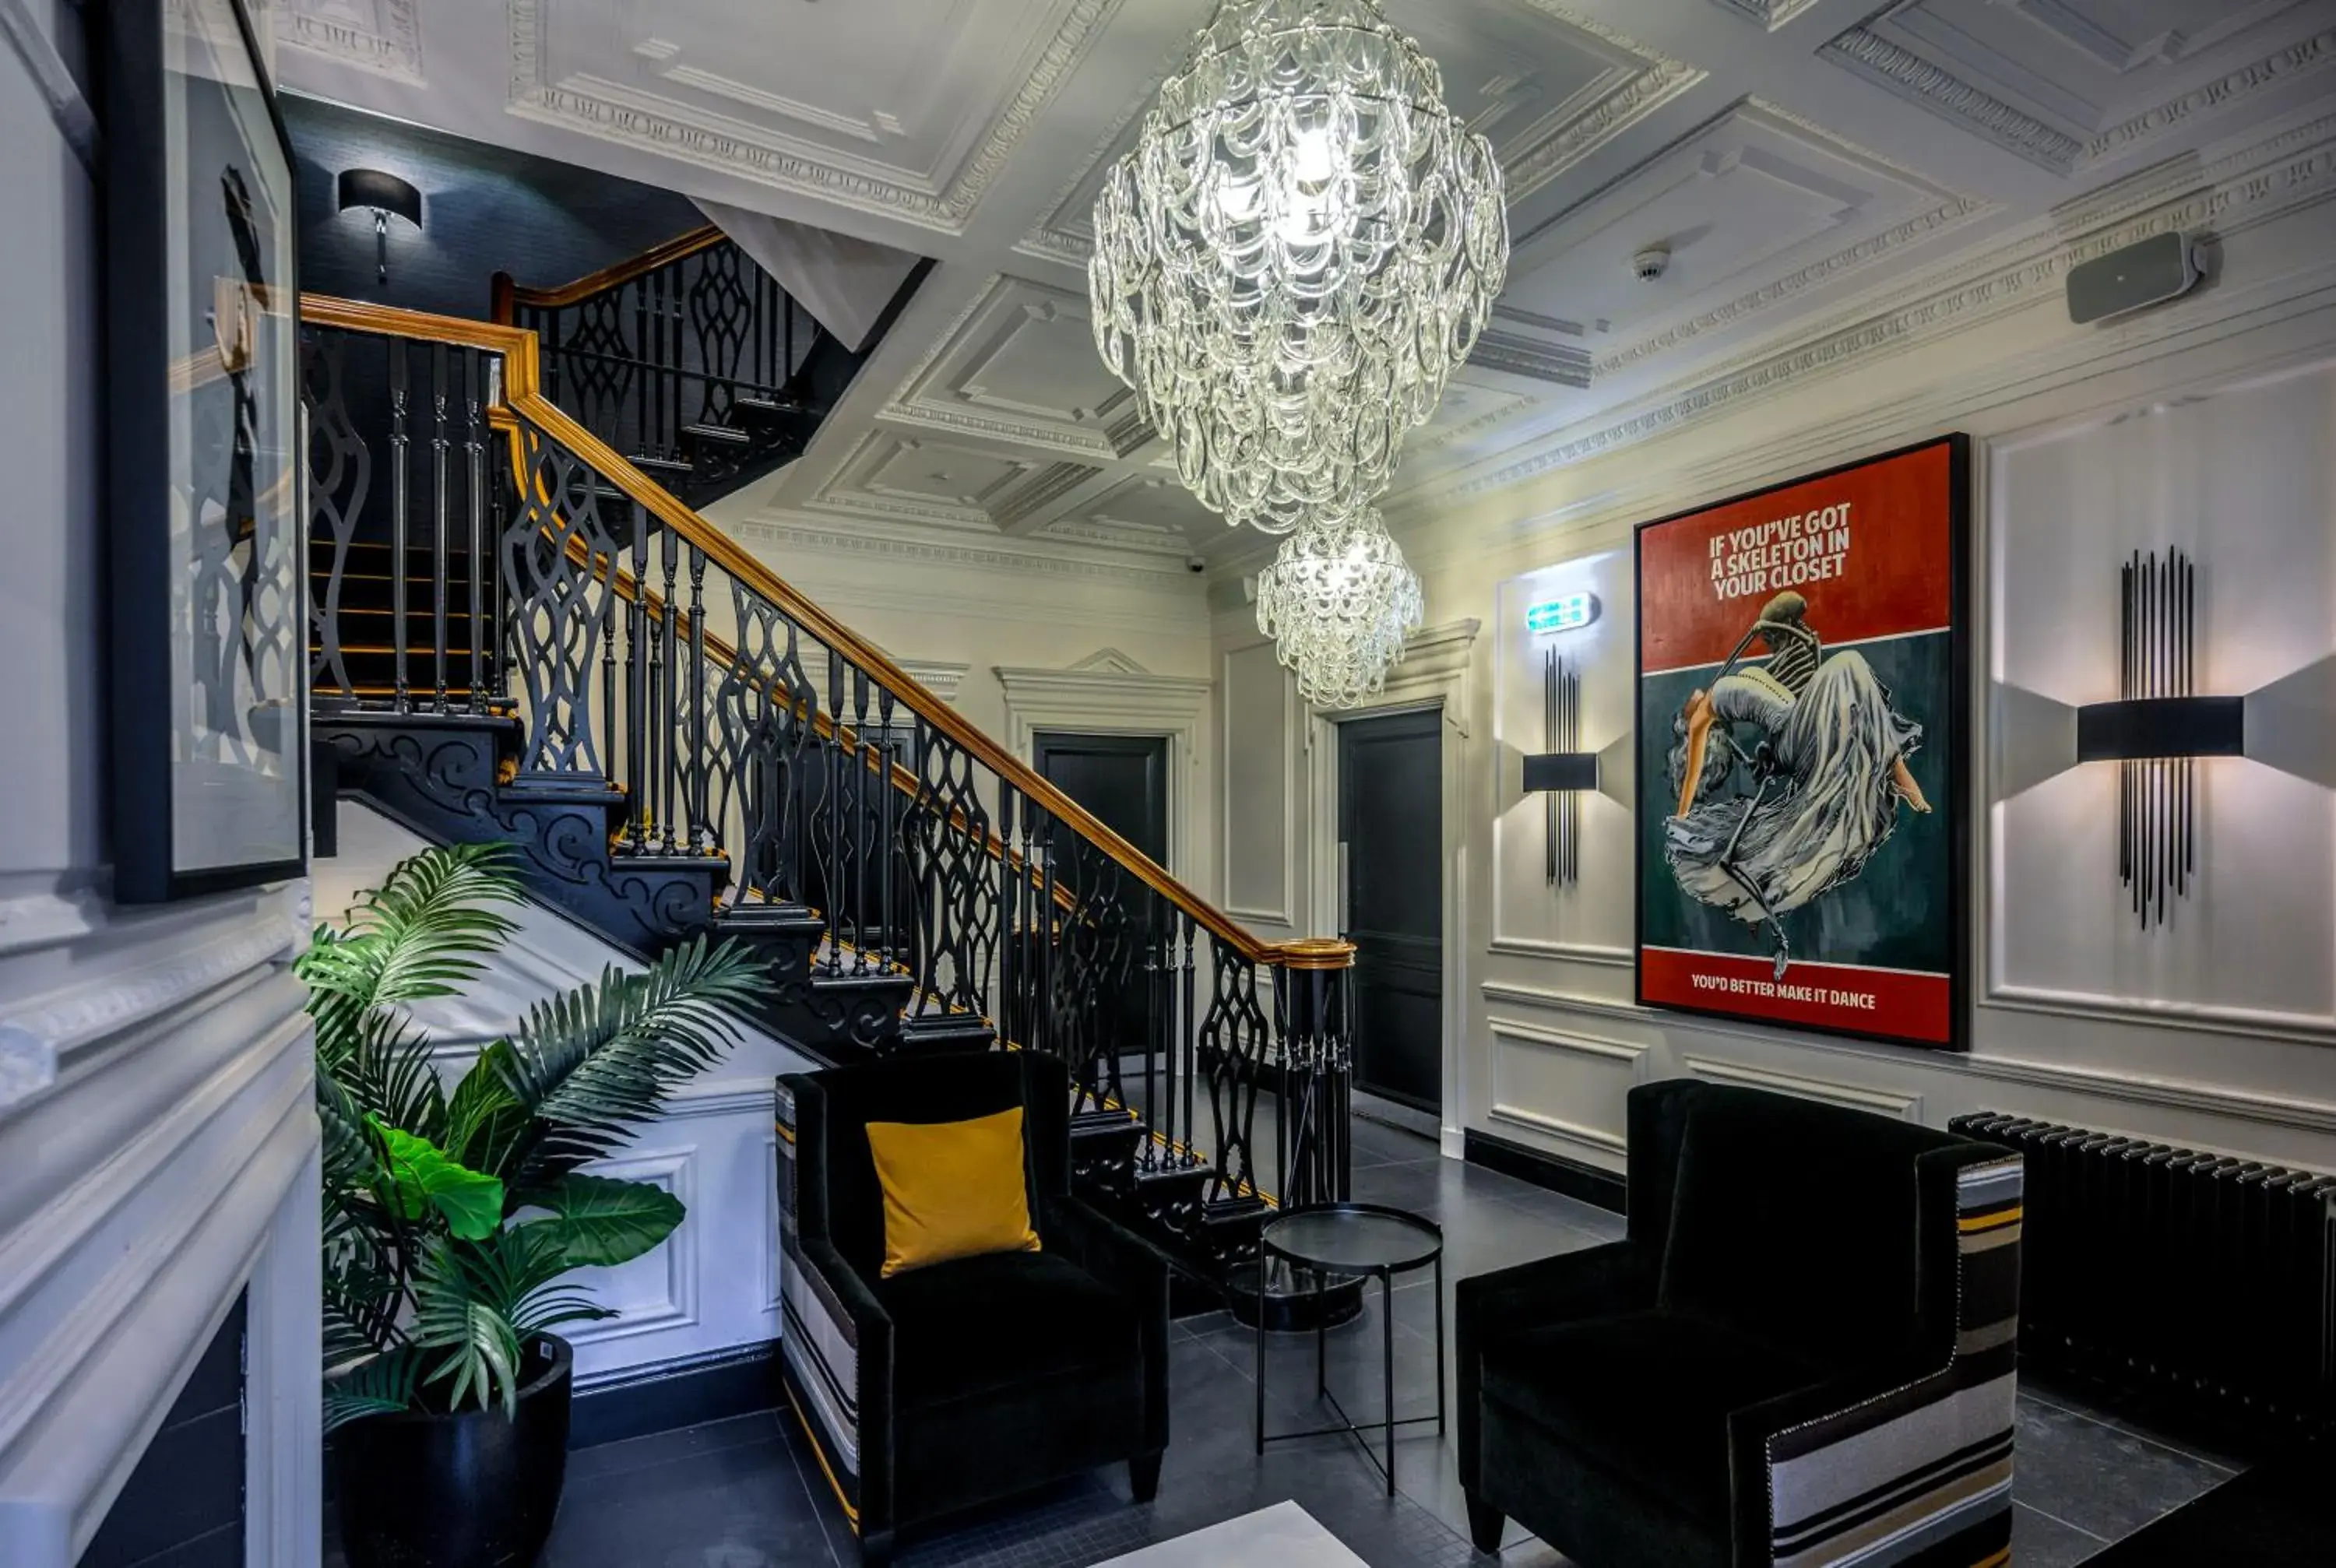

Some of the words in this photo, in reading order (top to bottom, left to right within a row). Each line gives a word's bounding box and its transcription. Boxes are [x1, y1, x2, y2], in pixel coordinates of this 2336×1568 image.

[1709, 535, 1726, 558] IF
[1728, 515, 1802, 552] YOU'VE
[1805, 502, 1851, 535] GOT
[1711, 558, 1724, 580] A
[1726, 533, 1823, 576] SKELETON
[1828, 527, 1850, 553] IN
[1713, 570, 1767, 600] YOUR
[1770, 553, 1846, 589] CLOSET
[1691, 973, 1728, 991] YOU'D
[1729, 978, 1775, 997] BETTER
[1777, 984, 1813, 1002] MAKE
[1814, 988, 1828, 1004] IT
[1830, 990, 1876, 1010] DANCE
